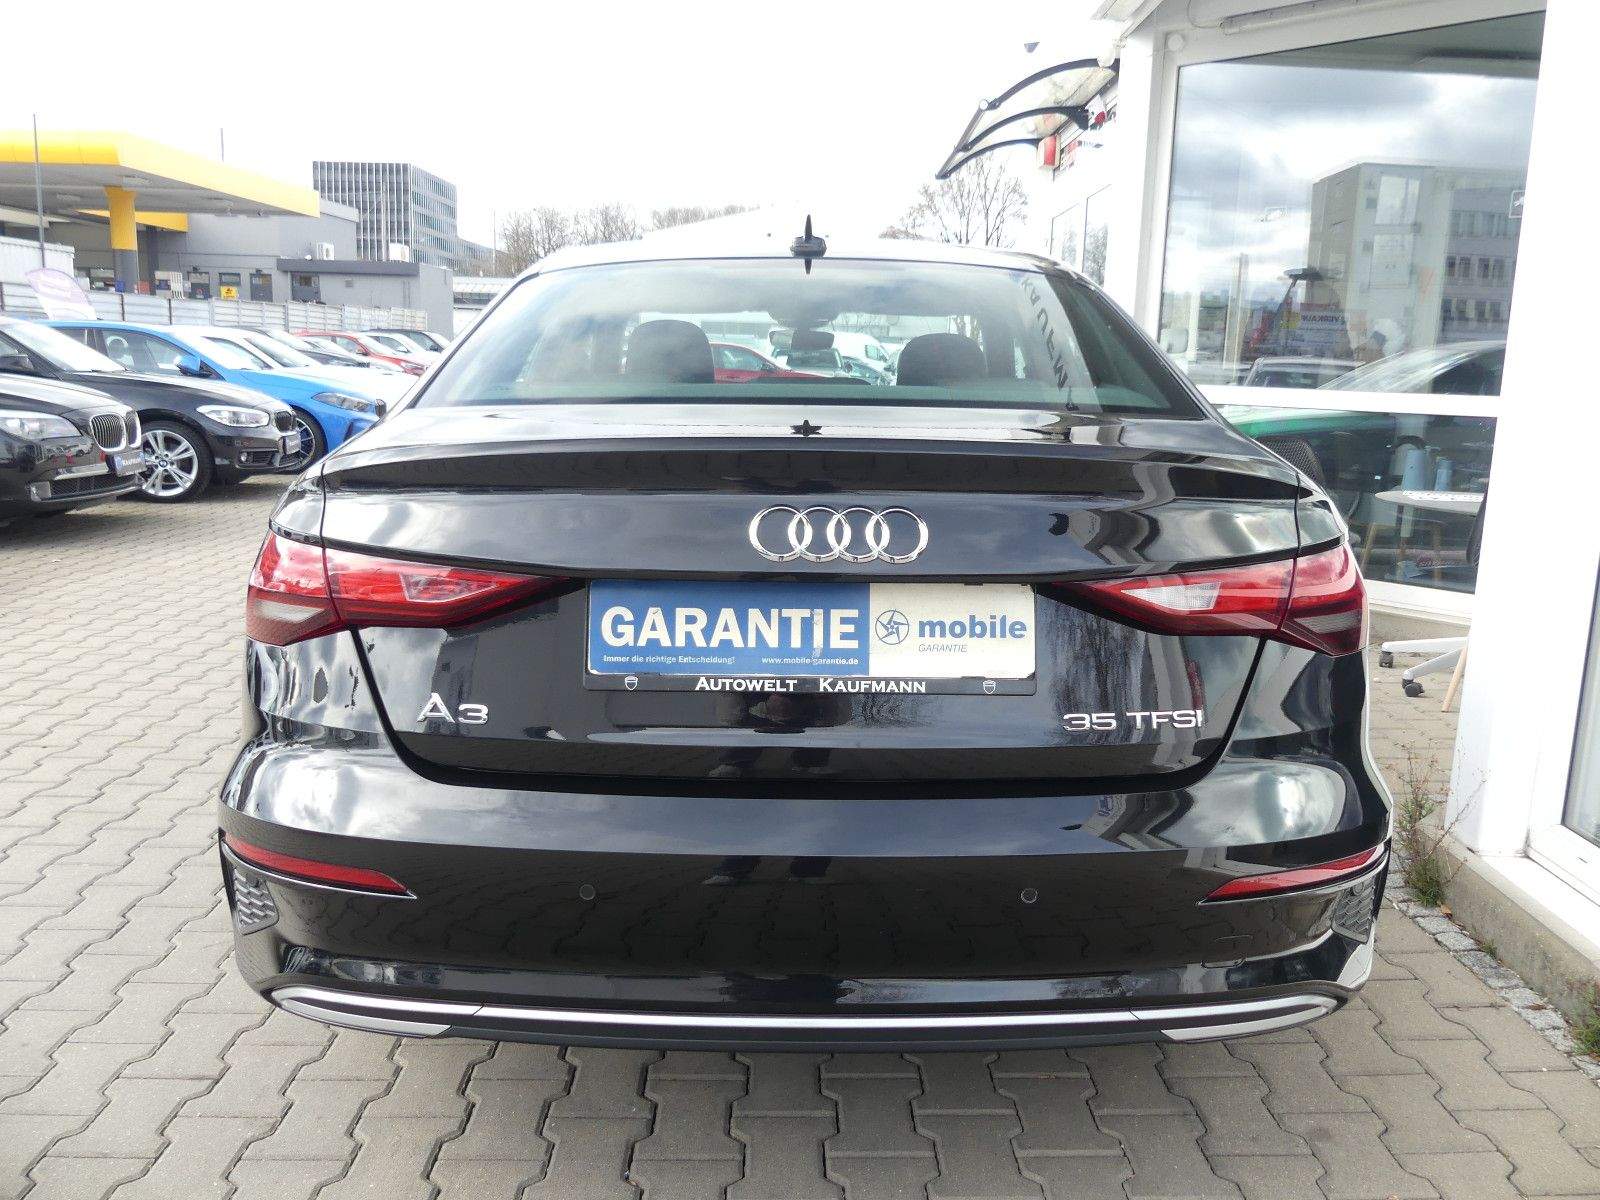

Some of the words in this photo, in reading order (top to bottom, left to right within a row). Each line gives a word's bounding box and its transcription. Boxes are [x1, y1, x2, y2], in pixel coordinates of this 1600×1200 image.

[601, 607, 859, 649] GARANTIE
[918, 615, 1027, 639] mobile
[918, 644, 968, 653] GARANTIE
[603, 654, 630, 663] Immer
[632, 654, 644, 663] die
[645, 654, 677, 665] richtige
[678, 655, 735, 666] Entscheidung!
[695, 677, 798, 692] AUTOWELT
[819, 677, 926, 693] KAUFMANN
[416, 692, 489, 725] A3
[1062, 712, 1117, 731] 35
[1126, 709, 1204, 729] TFSI
